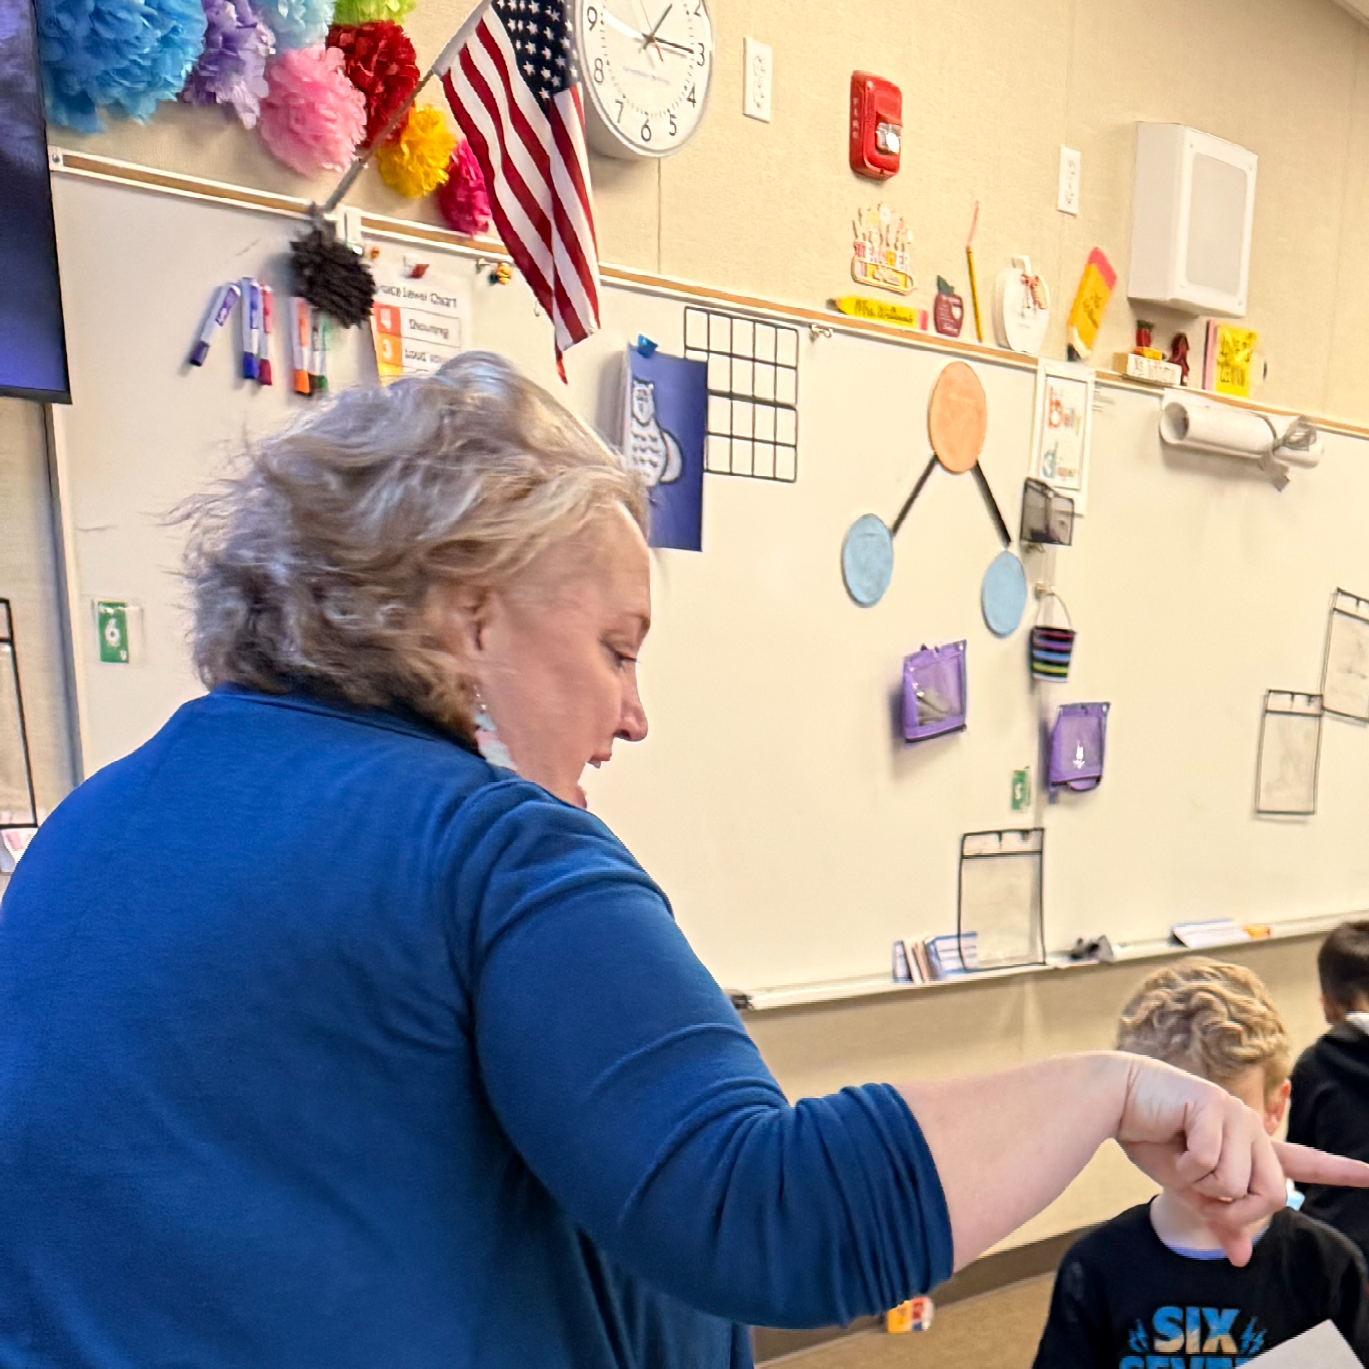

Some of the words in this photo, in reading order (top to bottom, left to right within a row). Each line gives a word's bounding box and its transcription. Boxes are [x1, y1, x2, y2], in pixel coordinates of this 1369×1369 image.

[586, 6, 598, 31] 9
[696, 43, 705, 66] 3
[593, 58, 604, 84] 8
[686, 82, 697, 108] 4
[615, 98, 624, 124] 7
[640, 118, 652, 142] 6
[668, 112, 677, 136] 5
[1152, 1305, 1241, 1354] SIX
